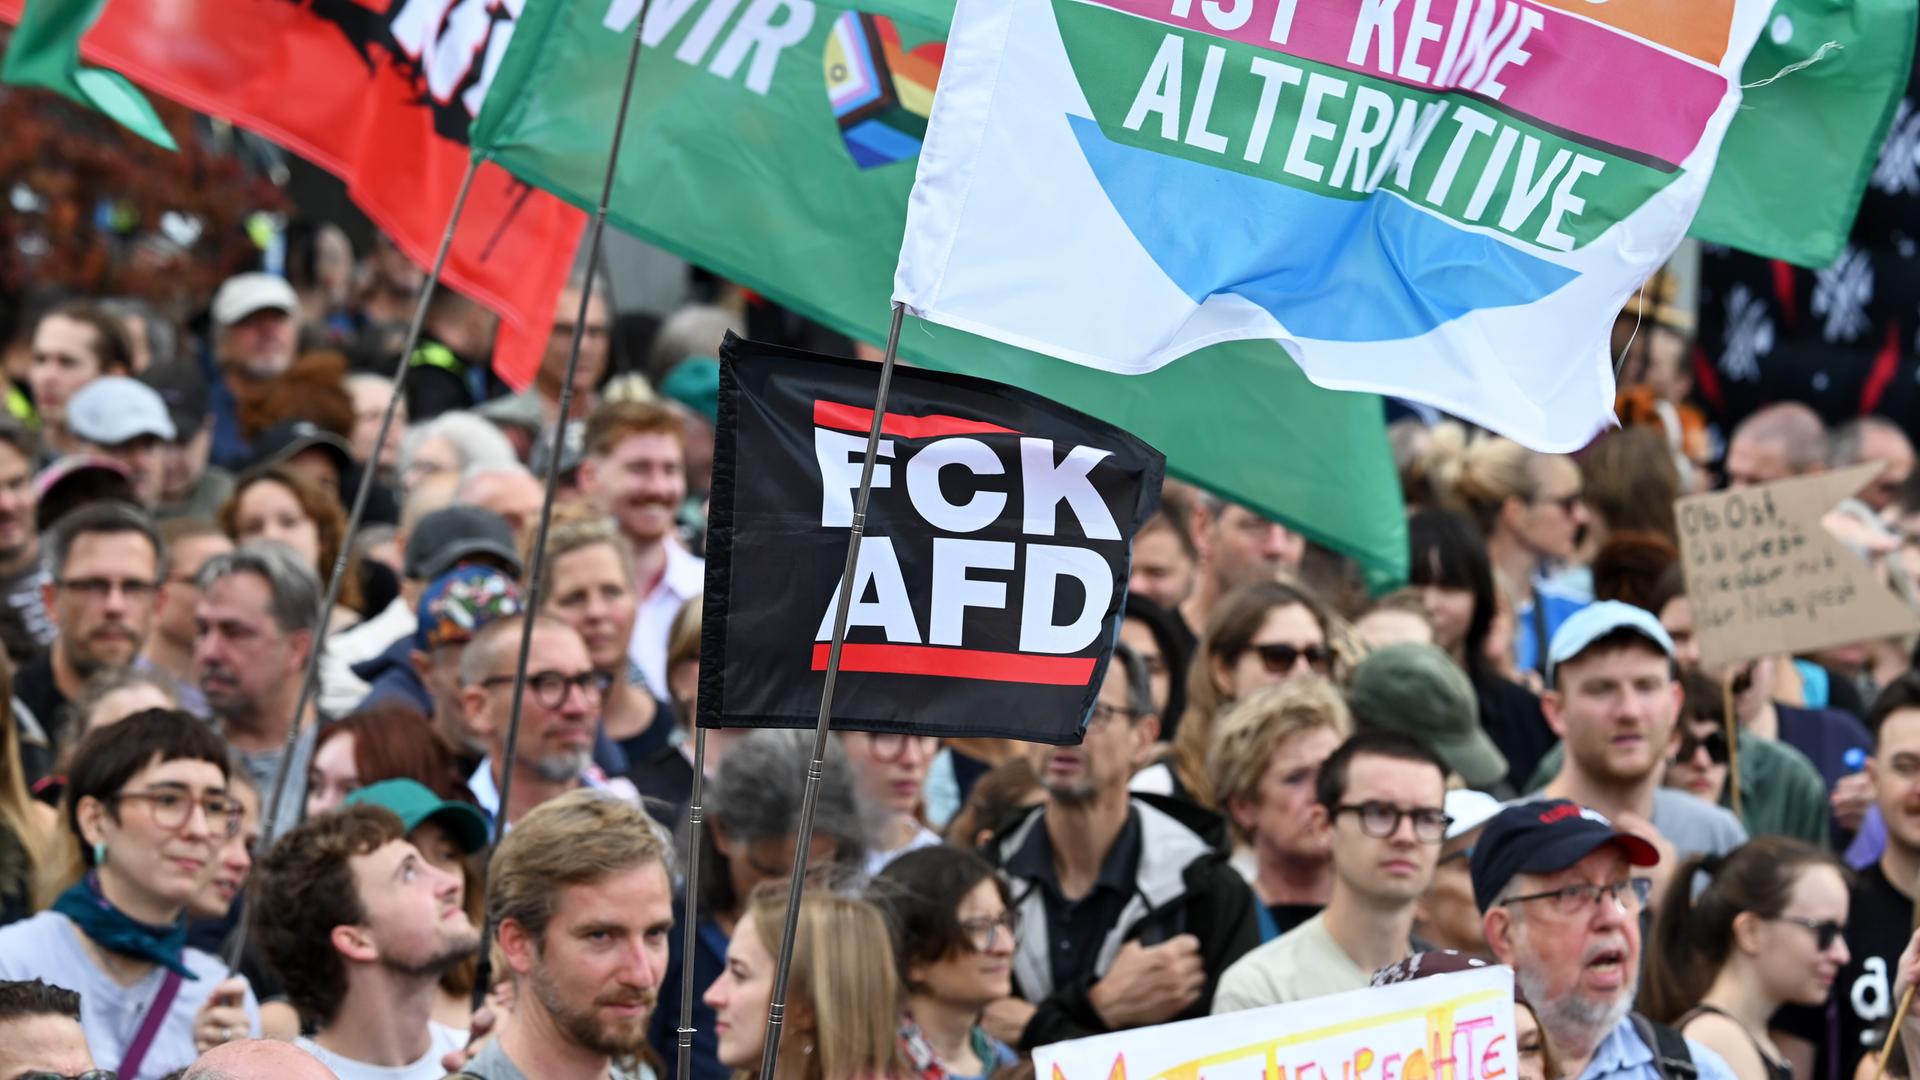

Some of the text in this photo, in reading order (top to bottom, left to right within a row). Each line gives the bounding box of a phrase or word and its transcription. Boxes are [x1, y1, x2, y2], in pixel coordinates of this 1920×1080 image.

[1346, 0, 1545, 100] KEINE
[1122, 33, 1606, 251] ALTERNATIVE
[814, 426, 1123, 541] FCK
[815, 536, 1114, 654] AFD
